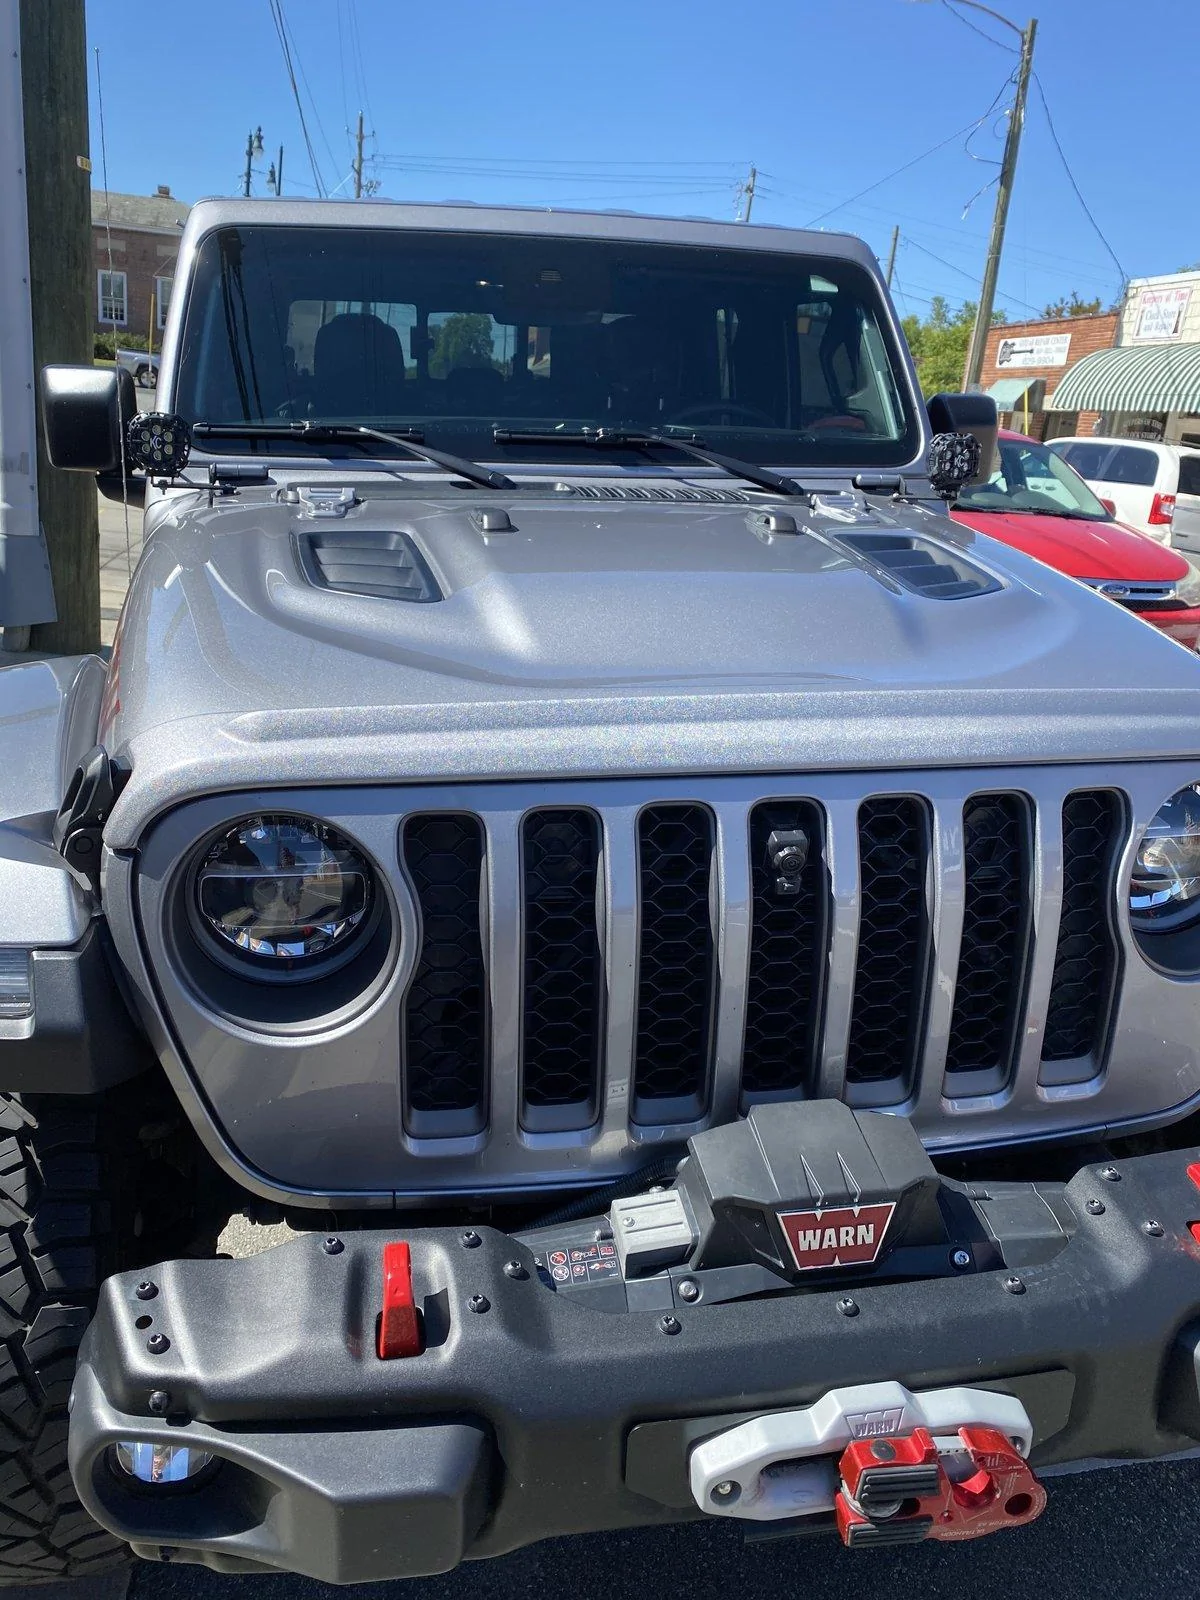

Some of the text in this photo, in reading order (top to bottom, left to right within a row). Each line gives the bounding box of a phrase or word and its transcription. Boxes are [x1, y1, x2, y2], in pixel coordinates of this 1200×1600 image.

[150, 435, 162, 449] KC
[797, 1223, 875, 1252] WARN
[855, 1419, 895, 1438] WARN
